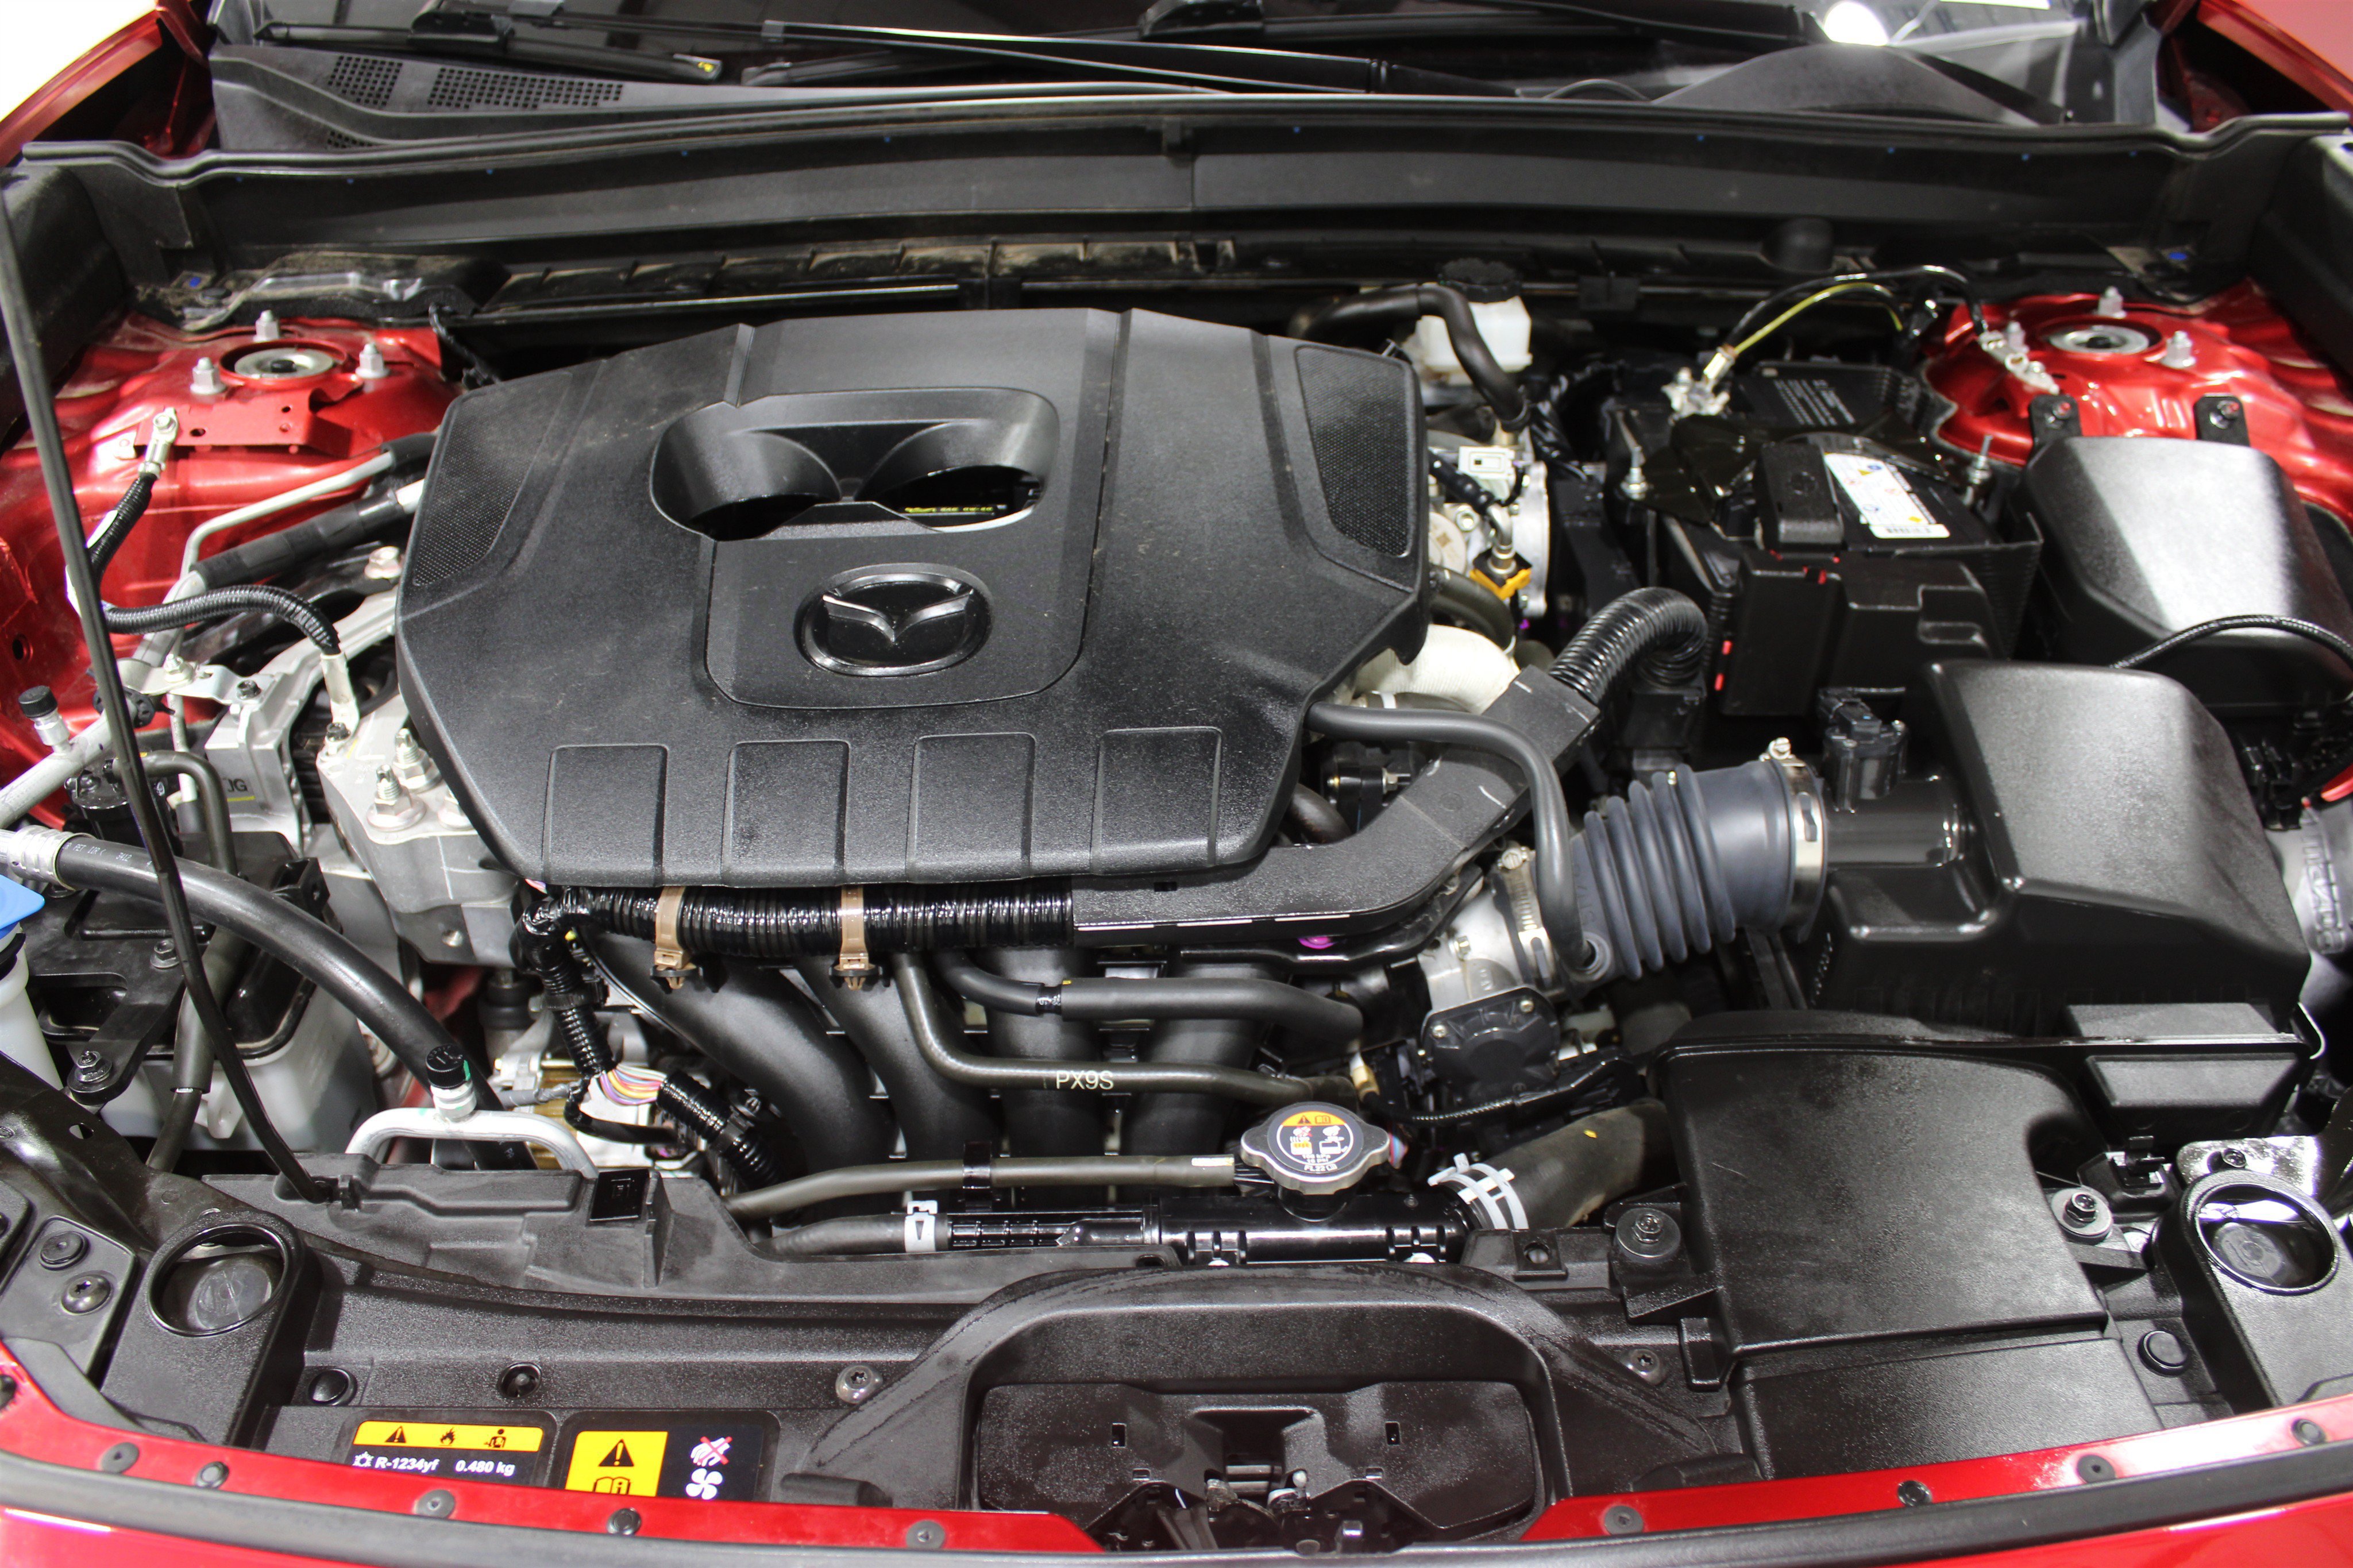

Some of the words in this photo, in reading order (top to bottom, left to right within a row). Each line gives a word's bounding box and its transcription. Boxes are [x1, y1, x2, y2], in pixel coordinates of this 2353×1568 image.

[1056, 1070, 1114, 1090] PX9S
[375, 1456, 440, 1474] R-1234yf
[455, 1459, 494, 1473] 0.480
[496, 1461, 516, 1477] kg
